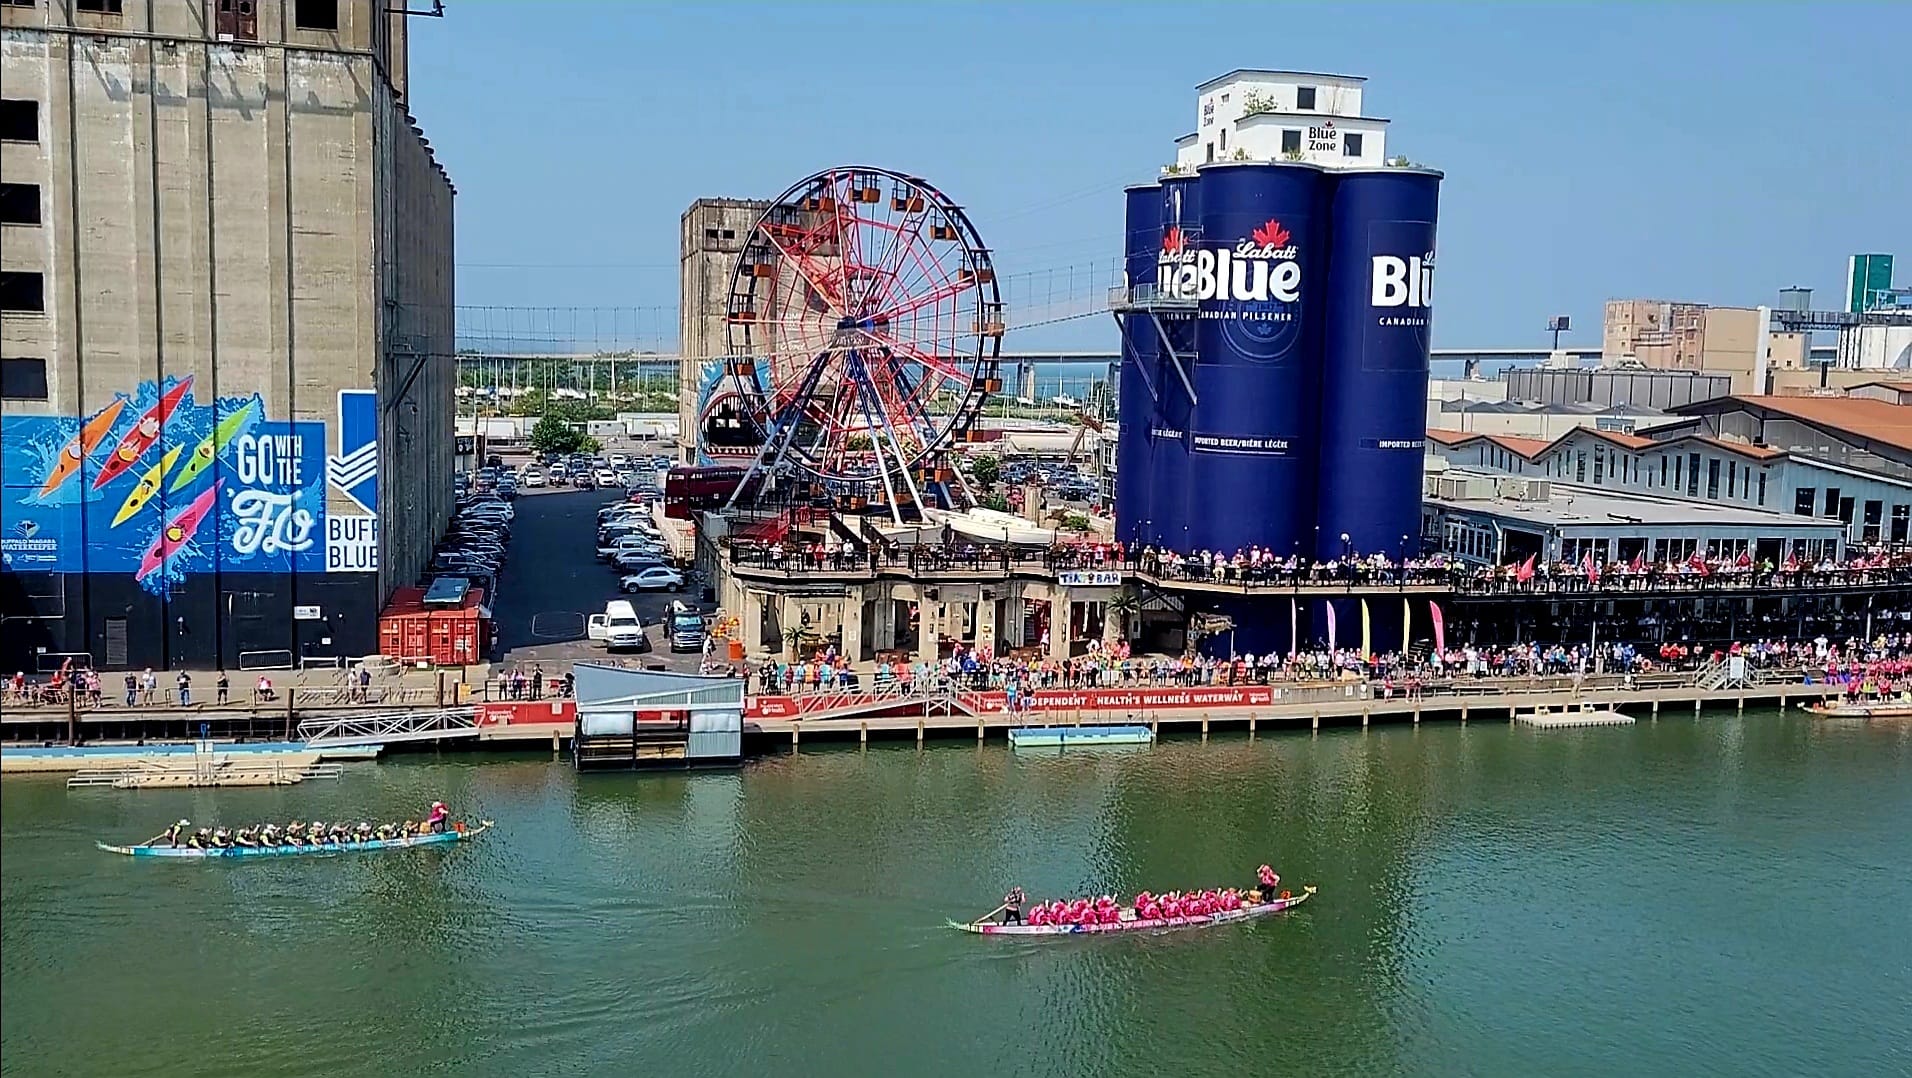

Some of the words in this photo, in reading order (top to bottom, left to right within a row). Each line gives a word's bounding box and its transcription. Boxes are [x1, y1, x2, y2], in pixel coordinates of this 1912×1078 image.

[1308, 126, 1337, 140] Blue
[1308, 140, 1337, 151] Zone
[1232, 238, 1297, 260] Labatt
[1198, 248, 1301, 302] Blue
[1242, 311, 1292, 321] PILSENER
[237, 434, 274, 485] GO
[1096, 573, 1119, 583] BAR
[1030, 696, 1087, 706] DEPENDENT
[1097, 695, 1140, 705] HEALTH'S
[1143, 694, 1190, 705] WELLNESS
[1193, 693, 1244, 703] WATERWAY
